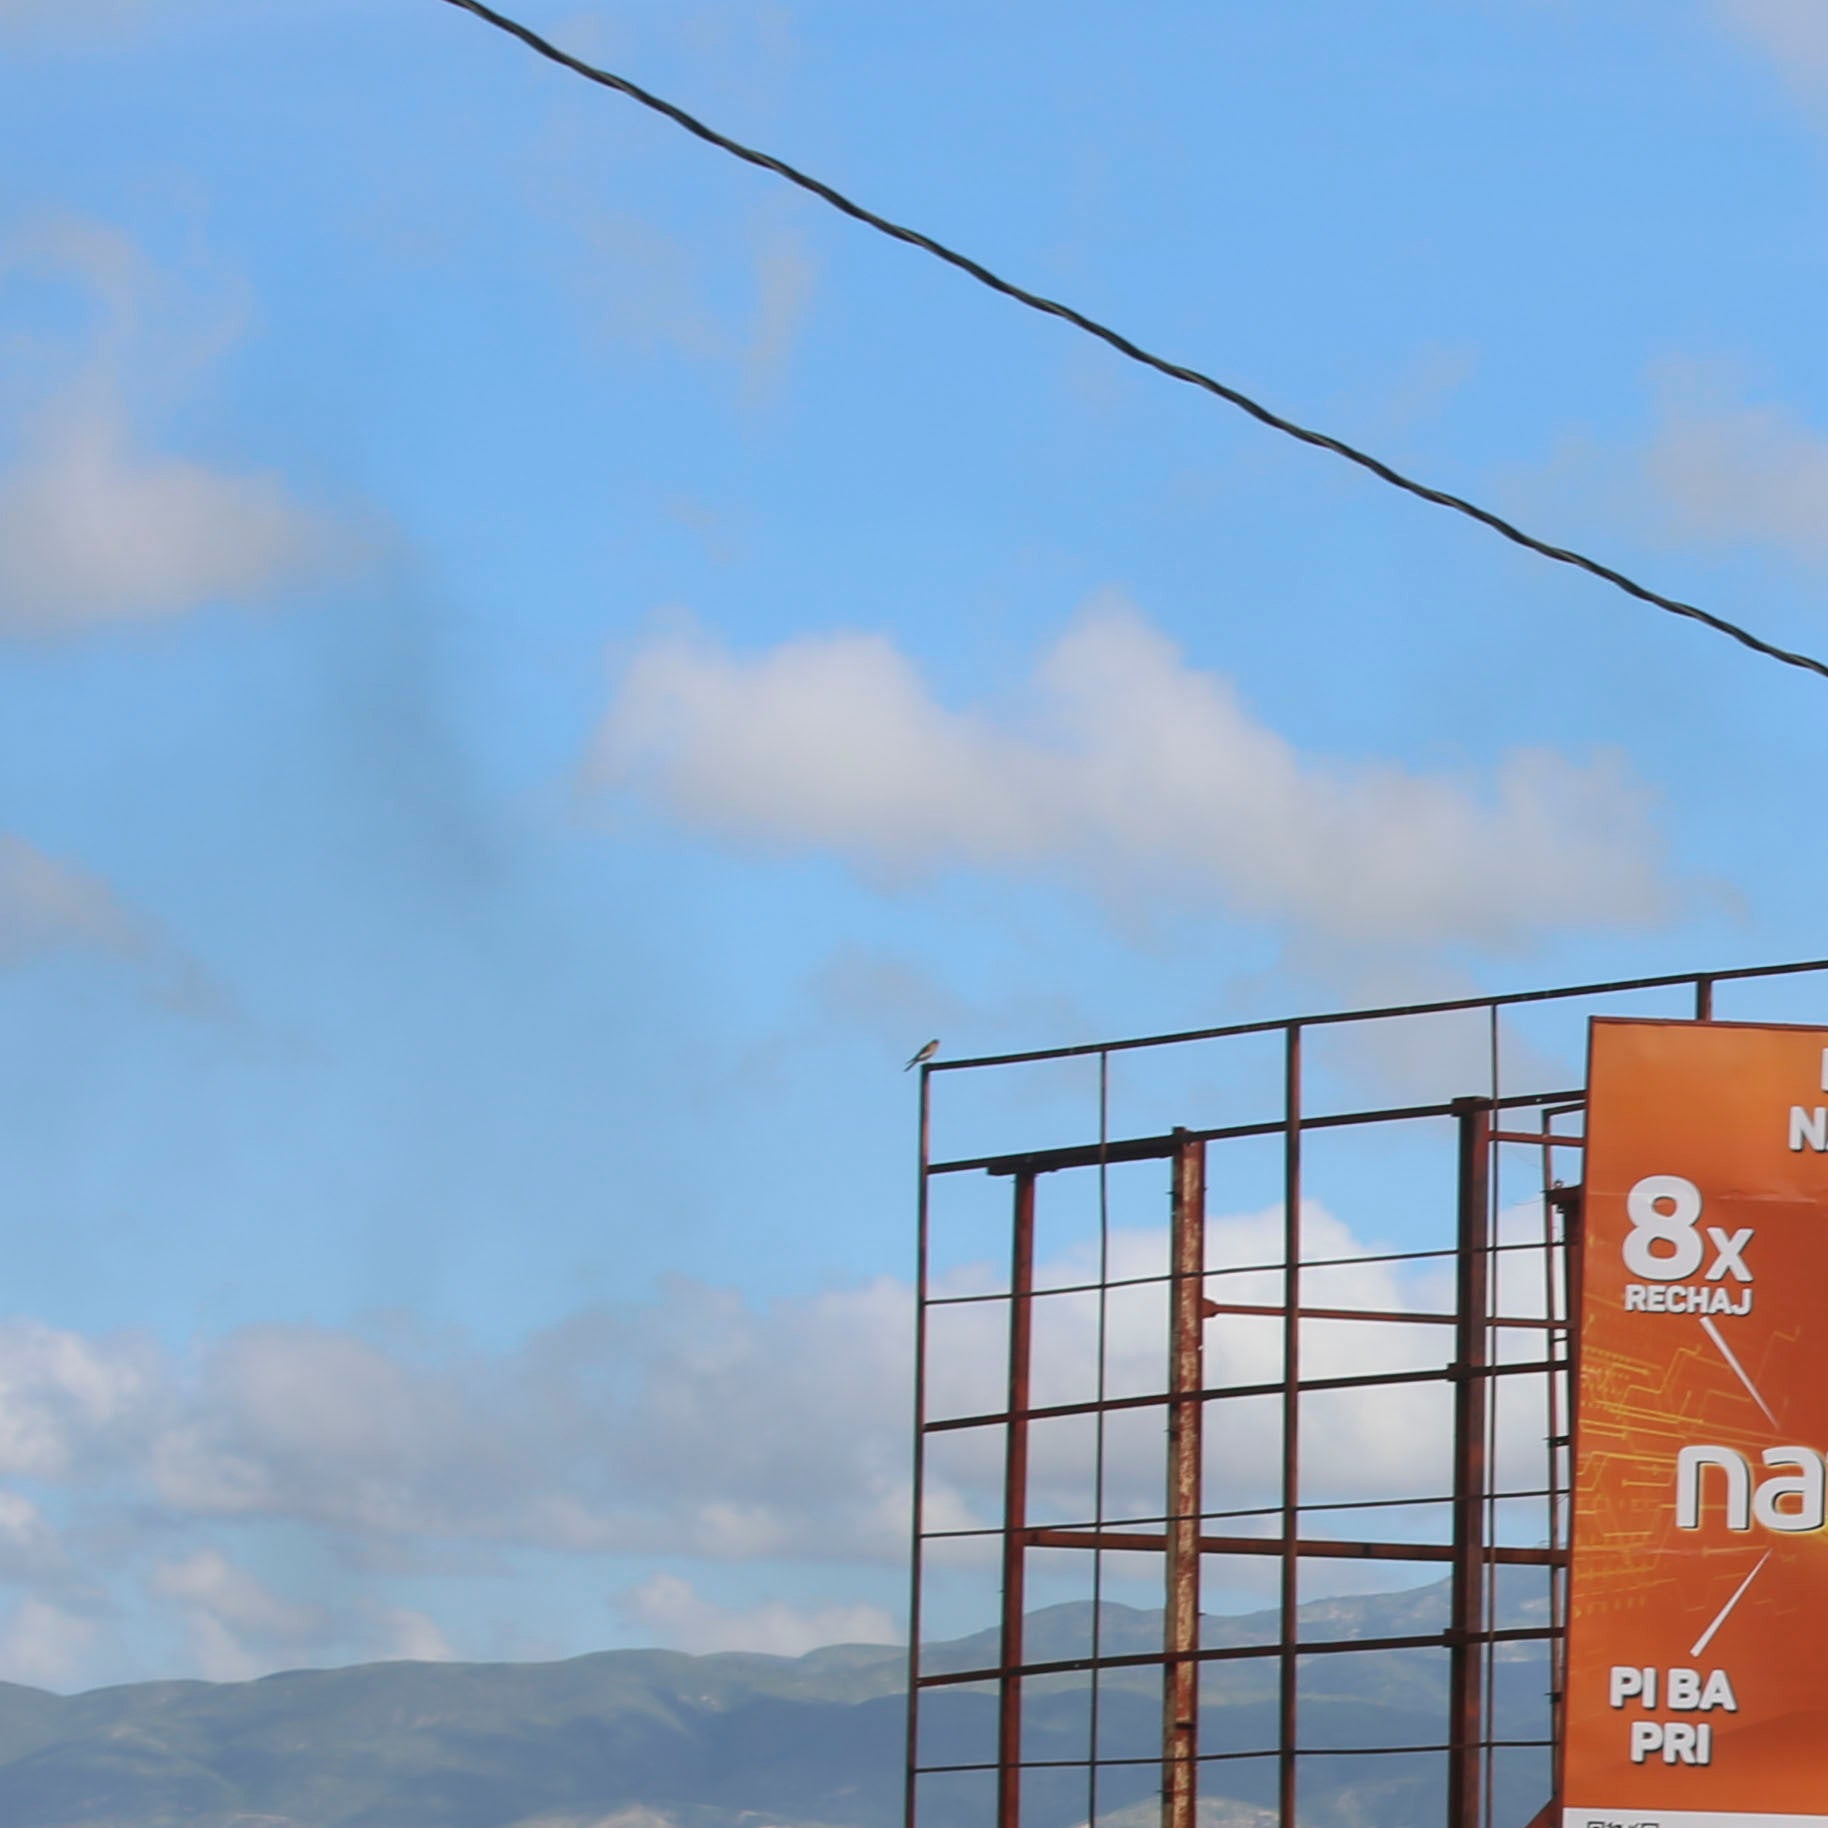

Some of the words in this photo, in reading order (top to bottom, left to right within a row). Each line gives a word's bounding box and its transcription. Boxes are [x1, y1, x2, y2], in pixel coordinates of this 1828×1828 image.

[1624, 1284, 1754, 1316] RECHAJ
[1609, 1665, 1658, 1710] PI
[1667, 1667, 1738, 1713] BA
[1629, 1720, 1712, 1766] PRI
